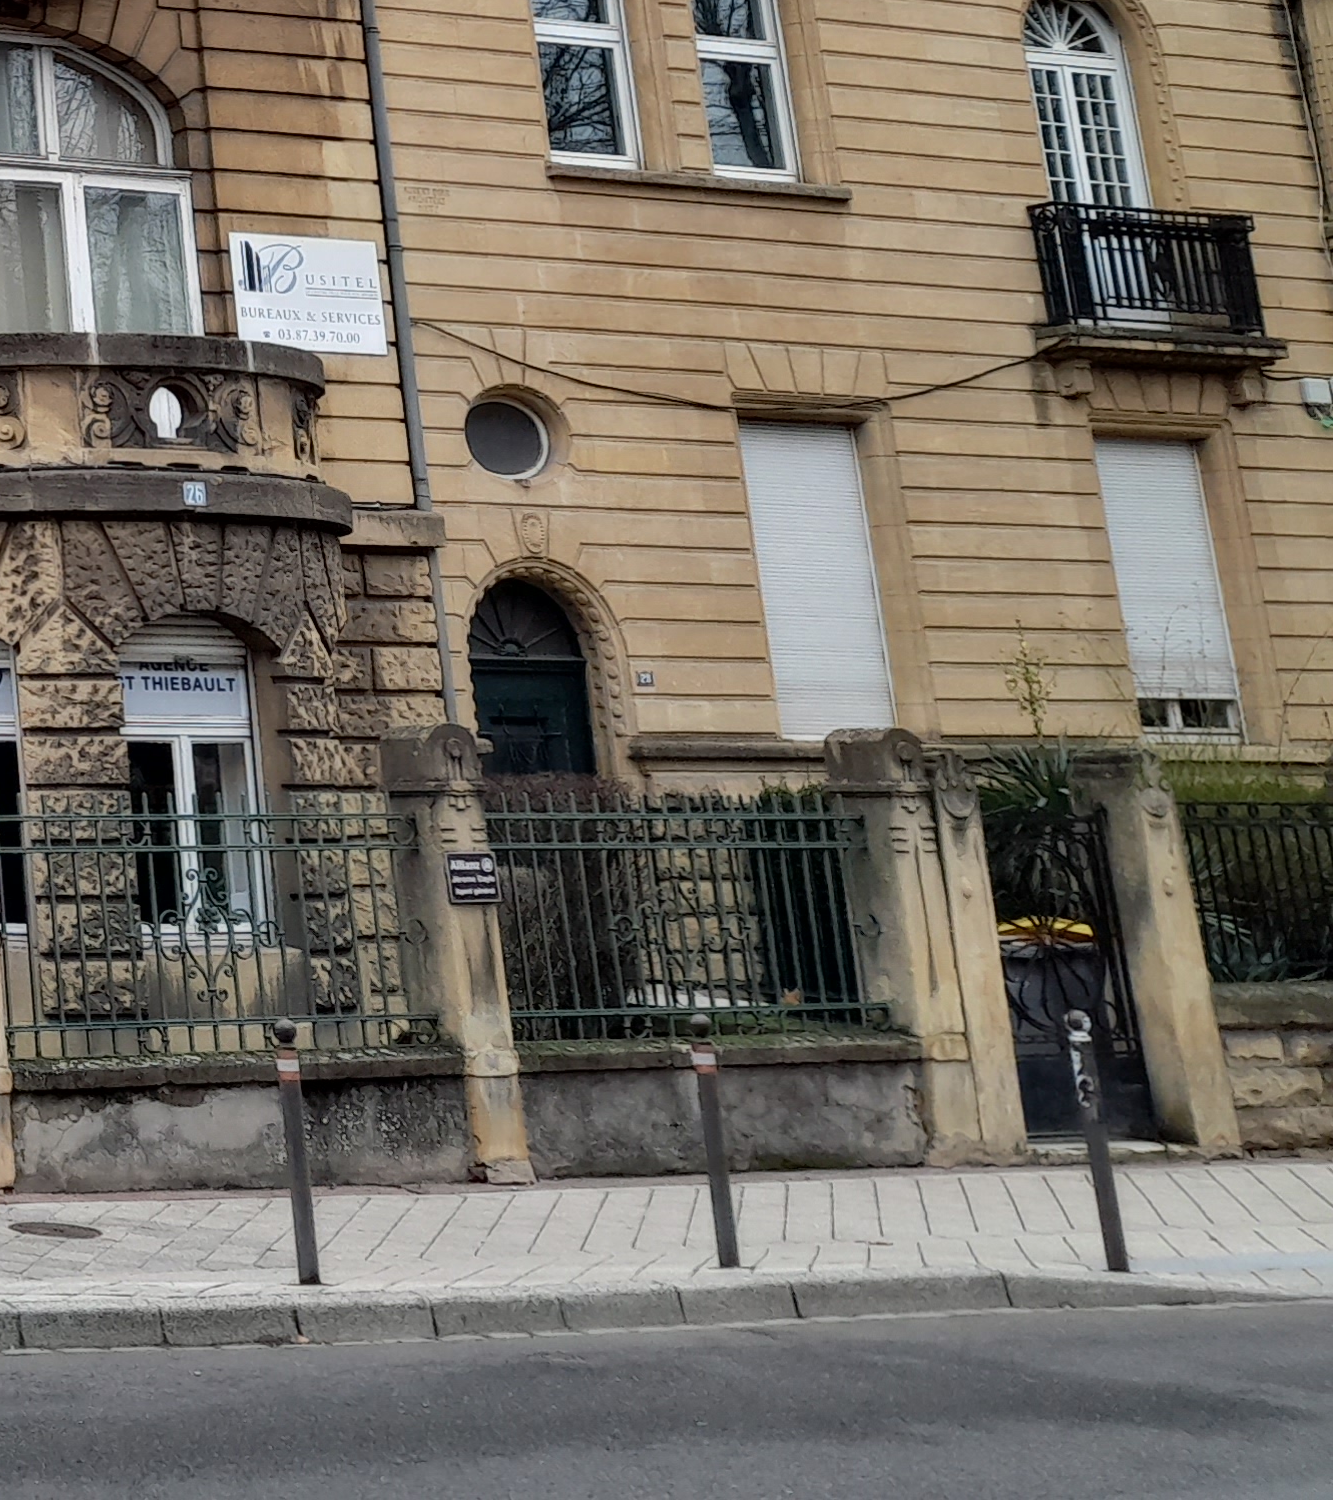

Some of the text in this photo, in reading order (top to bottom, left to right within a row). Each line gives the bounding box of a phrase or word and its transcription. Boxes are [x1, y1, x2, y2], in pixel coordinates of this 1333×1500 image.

[241, 306, 381, 325] BUREAUX & SERVICES
[278, 329, 360, 344] 03.87.39.70.00
[141, 676, 235, 692] THIEBAULT
